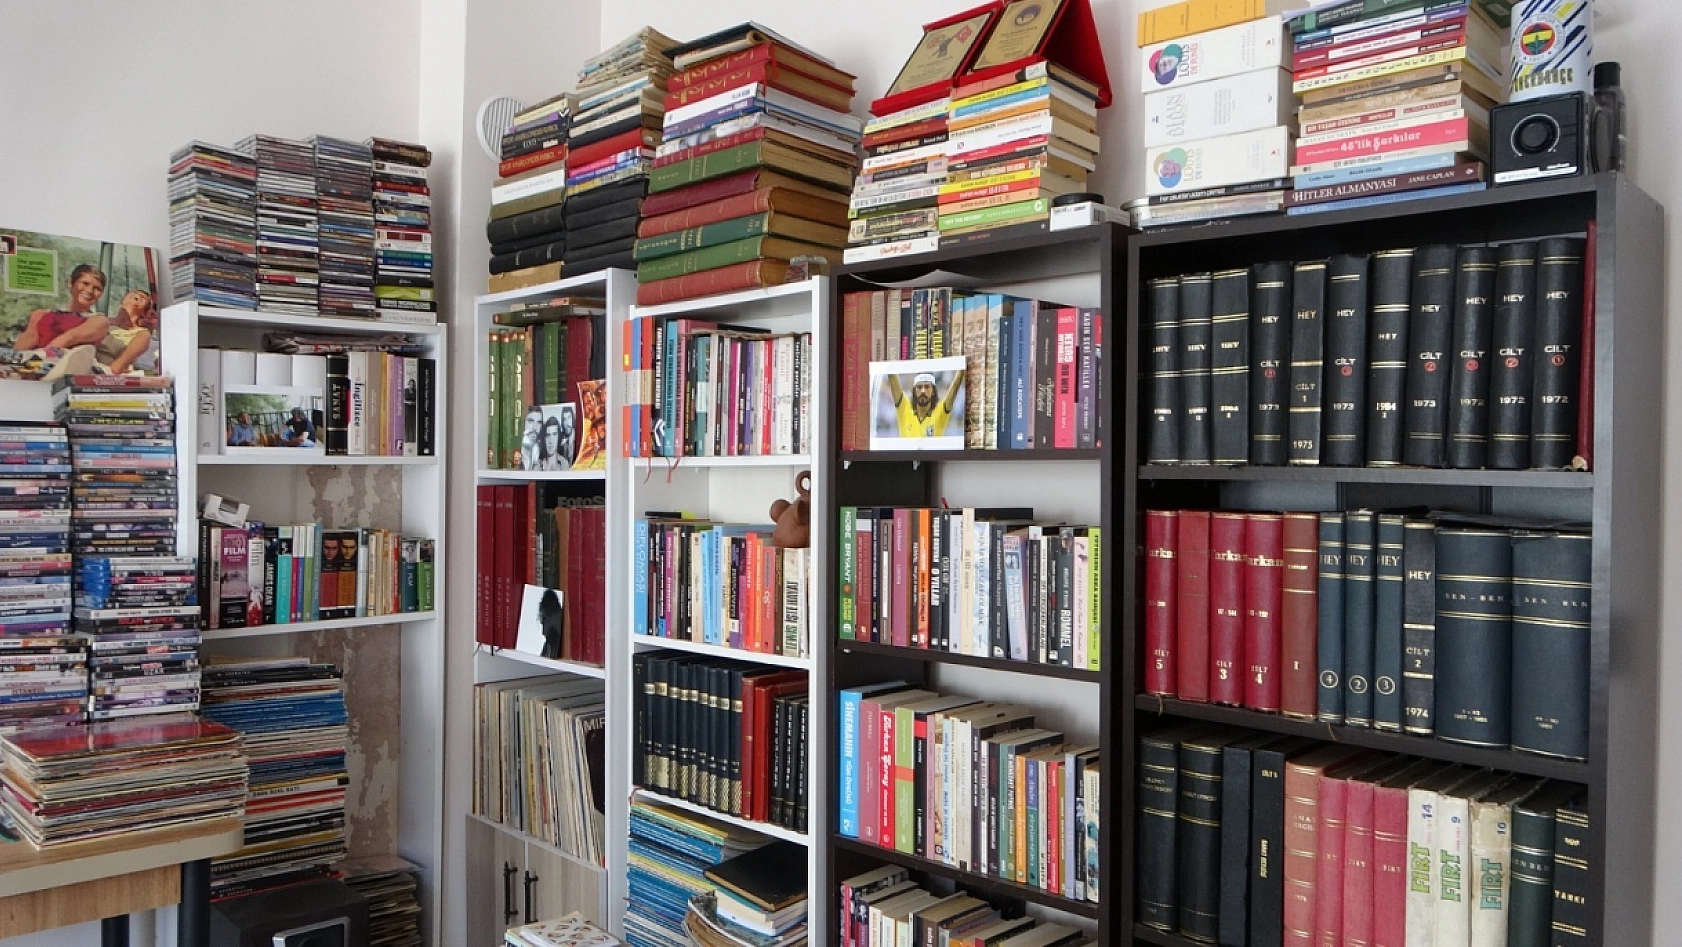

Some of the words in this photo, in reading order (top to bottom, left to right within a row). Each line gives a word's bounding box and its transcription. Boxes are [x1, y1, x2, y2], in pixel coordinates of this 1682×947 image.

[1178, 44, 1189, 77] LOUIS
[1184, 148, 1194, 182] LOUIS
[1335, 178, 1397, 197] ALMANYASI
[1466, 297, 1487, 305] HEY
[1503, 294, 1525, 302] HEY
[1546, 291, 1569, 299] HEY
[1298, 310, 1316, 319] HEY
[1337, 309, 1355, 317] HEY
[1083, 356, 1091, 389] KATİLLER
[1293, 440, 1313, 449] 1975
[266, 562, 274, 585] JAMES
[1409, 571, 1432, 580] HEY
[265, 587, 273, 605] DEAN
[931, 576, 939, 607] YILLAR
[1061, 610, 1070, 648] ROMMEL
[1156, 660, 1163, 669] 5
[1415, 660, 1421, 668] 2
[1219, 669, 1227, 679] 3
[1255, 673, 1263, 684] 4
[1405, 707, 1429, 718] 1974
[845, 701, 855, 757] SİNEMANIN
[1411, 842, 1431, 893] FIRT
[1422, 804, 1433, 819] 14
[1480, 858, 1503, 910] FIRT
[1497, 822, 1507, 834] 10
[1441, 849, 1462, 902] FIRT
